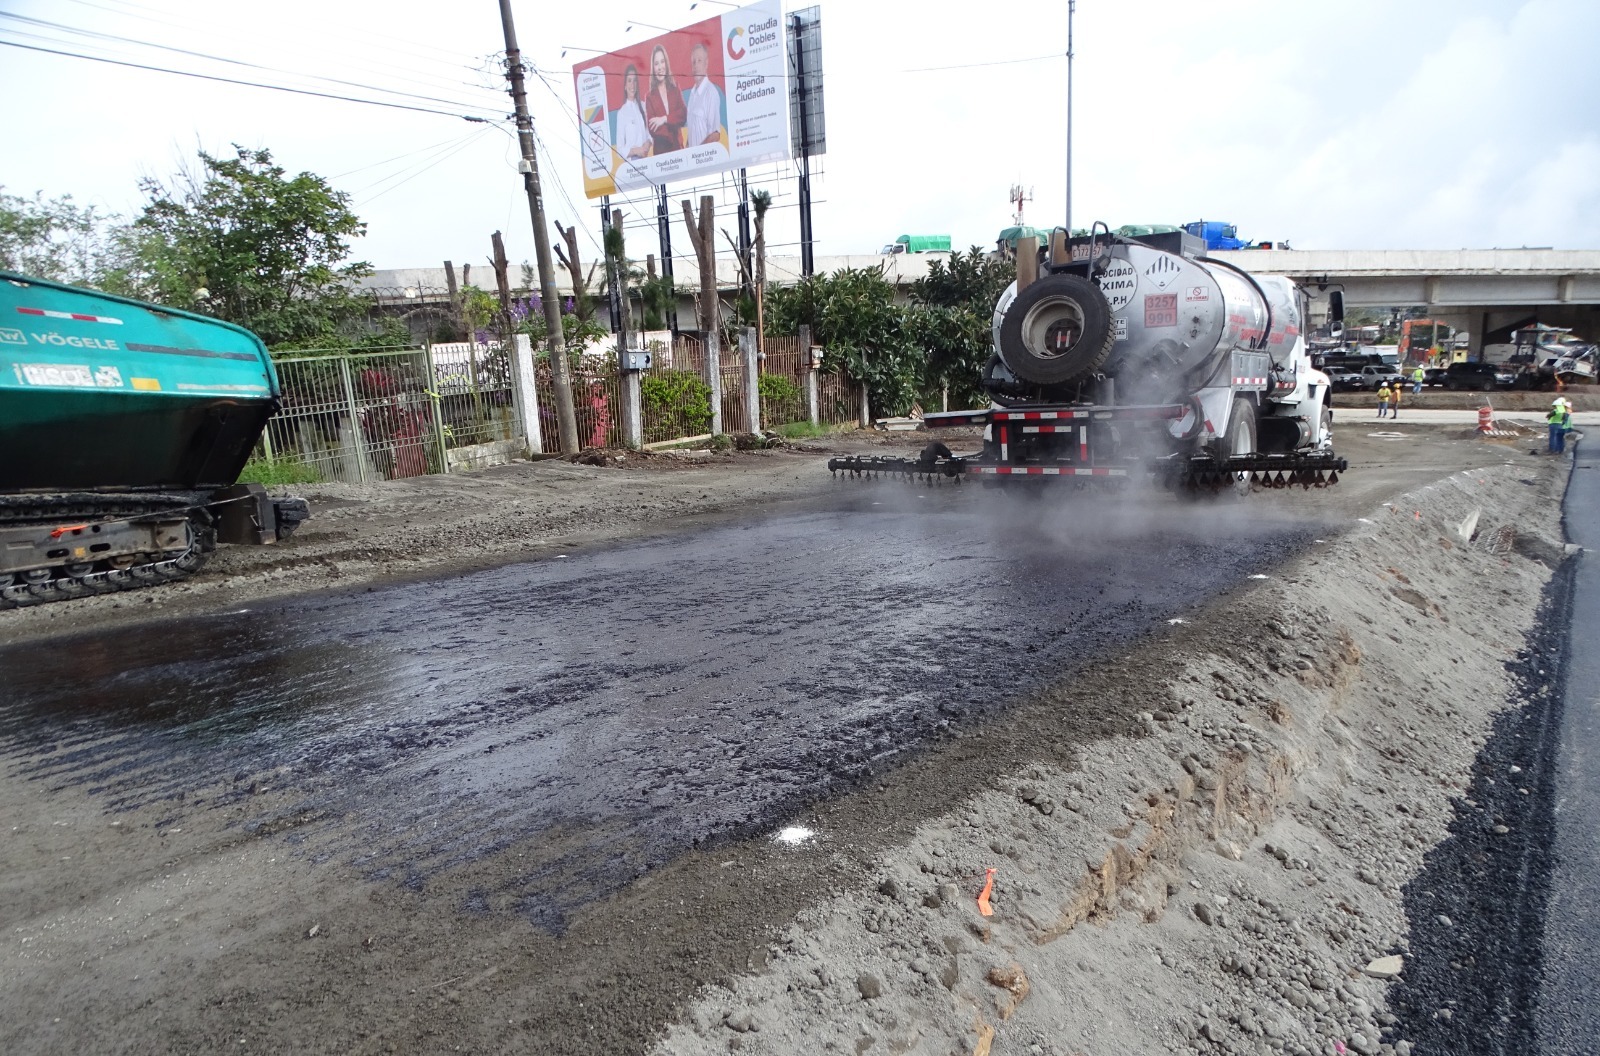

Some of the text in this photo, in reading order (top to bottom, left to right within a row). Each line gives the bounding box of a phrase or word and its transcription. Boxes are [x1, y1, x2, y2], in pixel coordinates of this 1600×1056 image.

[748, 18, 777, 34] Claudia
[749, 32, 776, 47] Dobles
[750, 42, 779, 55] PRESIDENTA
[736, 76, 765, 91] Agenda
[735, 86, 776, 103] Ciudadana
[1147, 295, 1175, 309] 3257
[1148, 312, 1172, 325] 990
[31, 332, 120, 350] VÖGELE
